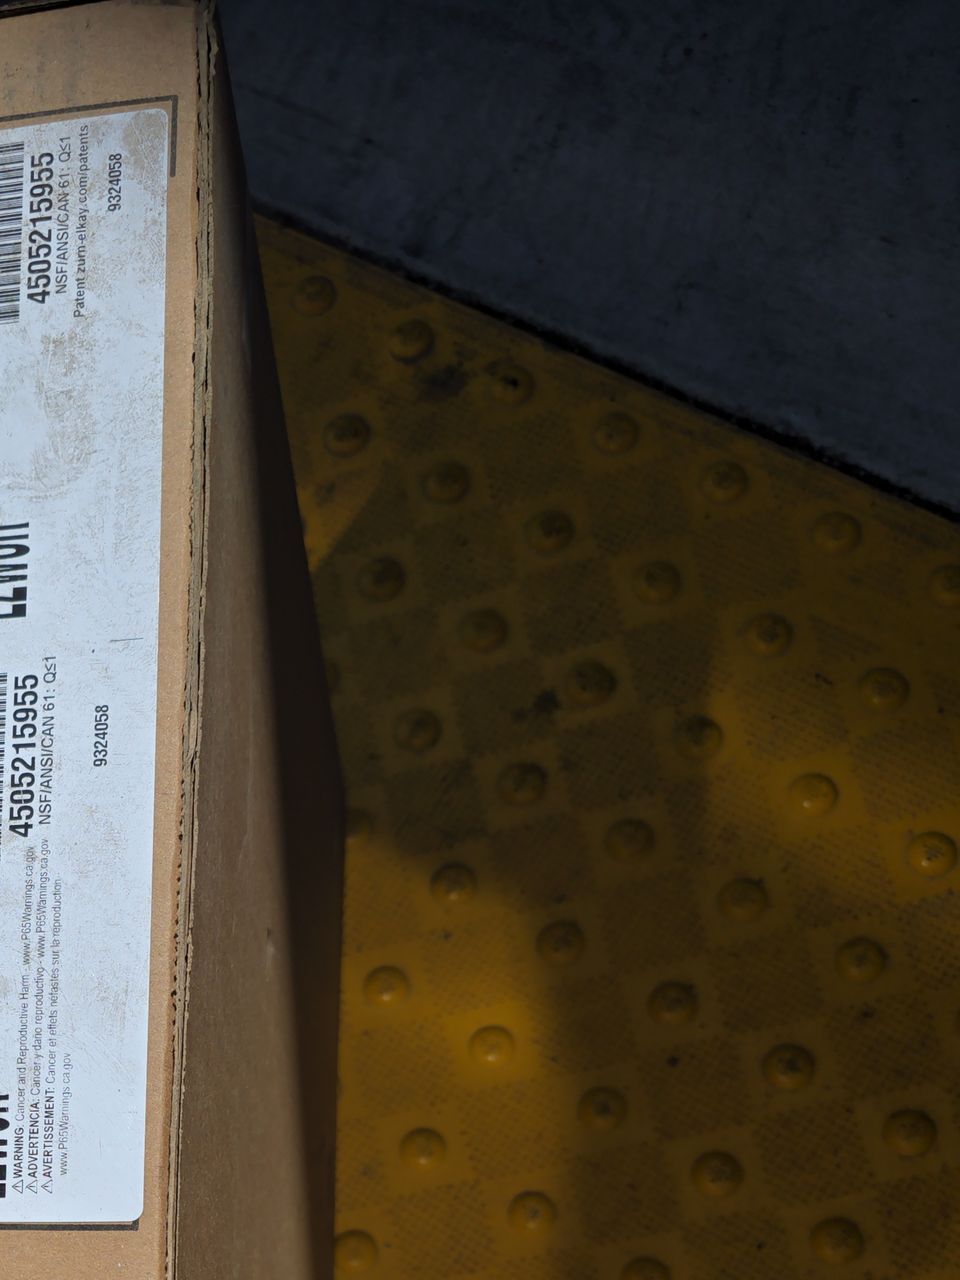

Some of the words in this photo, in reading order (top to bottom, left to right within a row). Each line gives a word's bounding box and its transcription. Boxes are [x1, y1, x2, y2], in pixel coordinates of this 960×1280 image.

[59, 167, 70, 188] 61:
[76, 125, 89, 273] zurn-elkay.com/patents
[108, 153, 122, 211] 9324058
[27, 152, 54, 304] 4505215955
[55, 193, 69, 294] NSF/ANSI/CAN
[74, 278, 85, 317] Patent
[43, 689, 55, 711] 61:
[9, 674, 38, 837] 4505215955
[94, 705, 108, 766] 9324058
[39, 716, 55, 824] NSF/ANSI/CAN
[53, 880, 62, 936] reproduction
[19, 975, 29, 999] Harm
[34, 967, 45, 1024] reproductivo
[17, 1003, 29, 1064] Reproductive
[47, 1010, 57, 1035] effets
[47, 1038, 56, 1046] et
[16, 1068, 27, 1084] and
[31, 1062, 41, 1095] Cancer
[46, 1050, 56, 1083] Cancer
[15, 1087, 26, 1121] Cancer
[13, 1125, 24, 1178] WARNING:
[28, 1099, 40, 1178] ADVERTENCIA:
[43, 1087, 55, 1178] AVERTISSEMENT:
